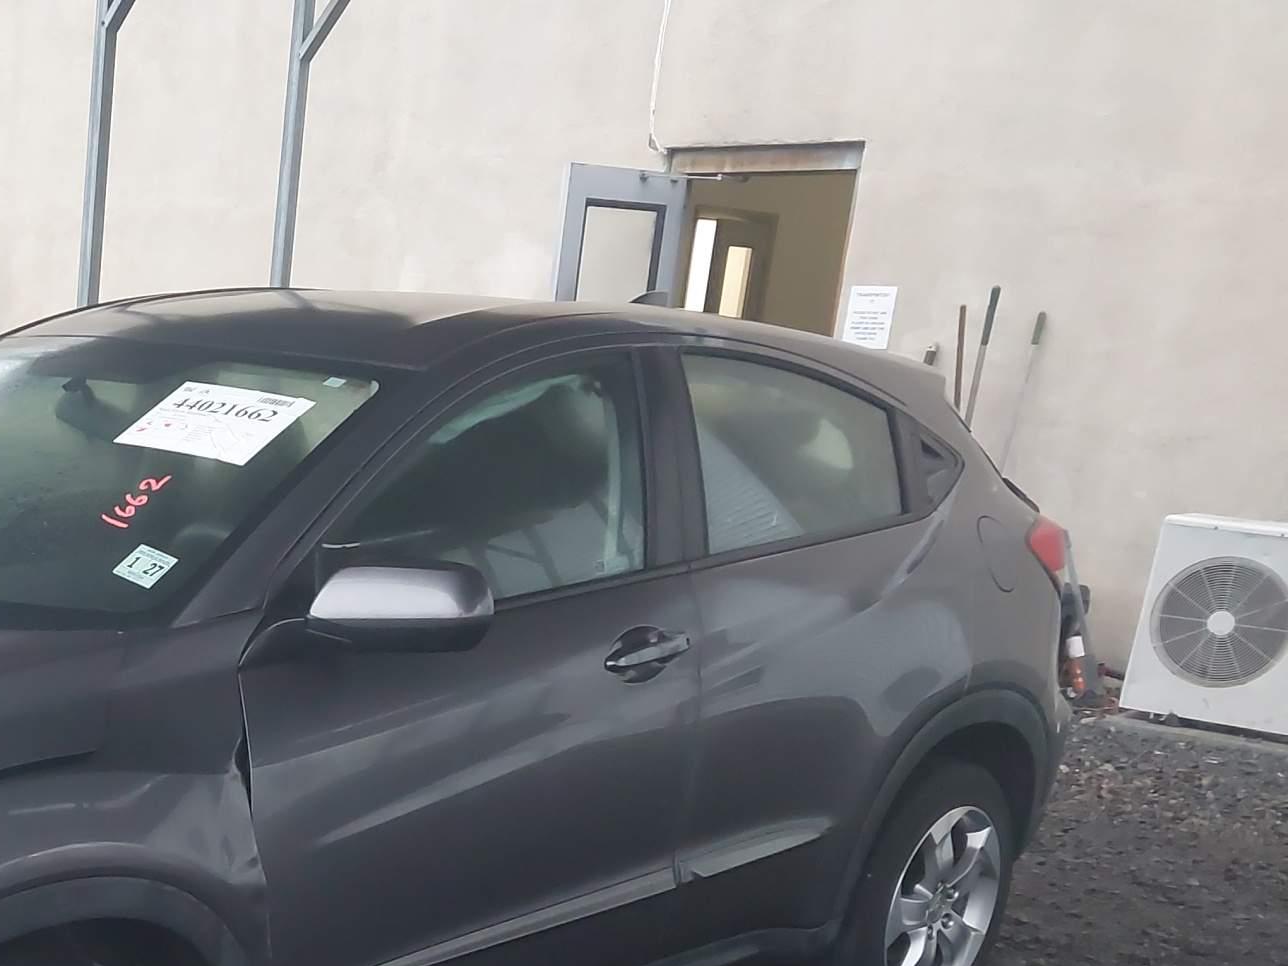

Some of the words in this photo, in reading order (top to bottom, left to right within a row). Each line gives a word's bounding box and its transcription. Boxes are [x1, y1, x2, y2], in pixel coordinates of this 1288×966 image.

[172, 397, 279, 422] 44021662
[100, 474, 173, 529] 1662
[126, 556, 142, 569] 1
[142, 562, 166, 577] 27
